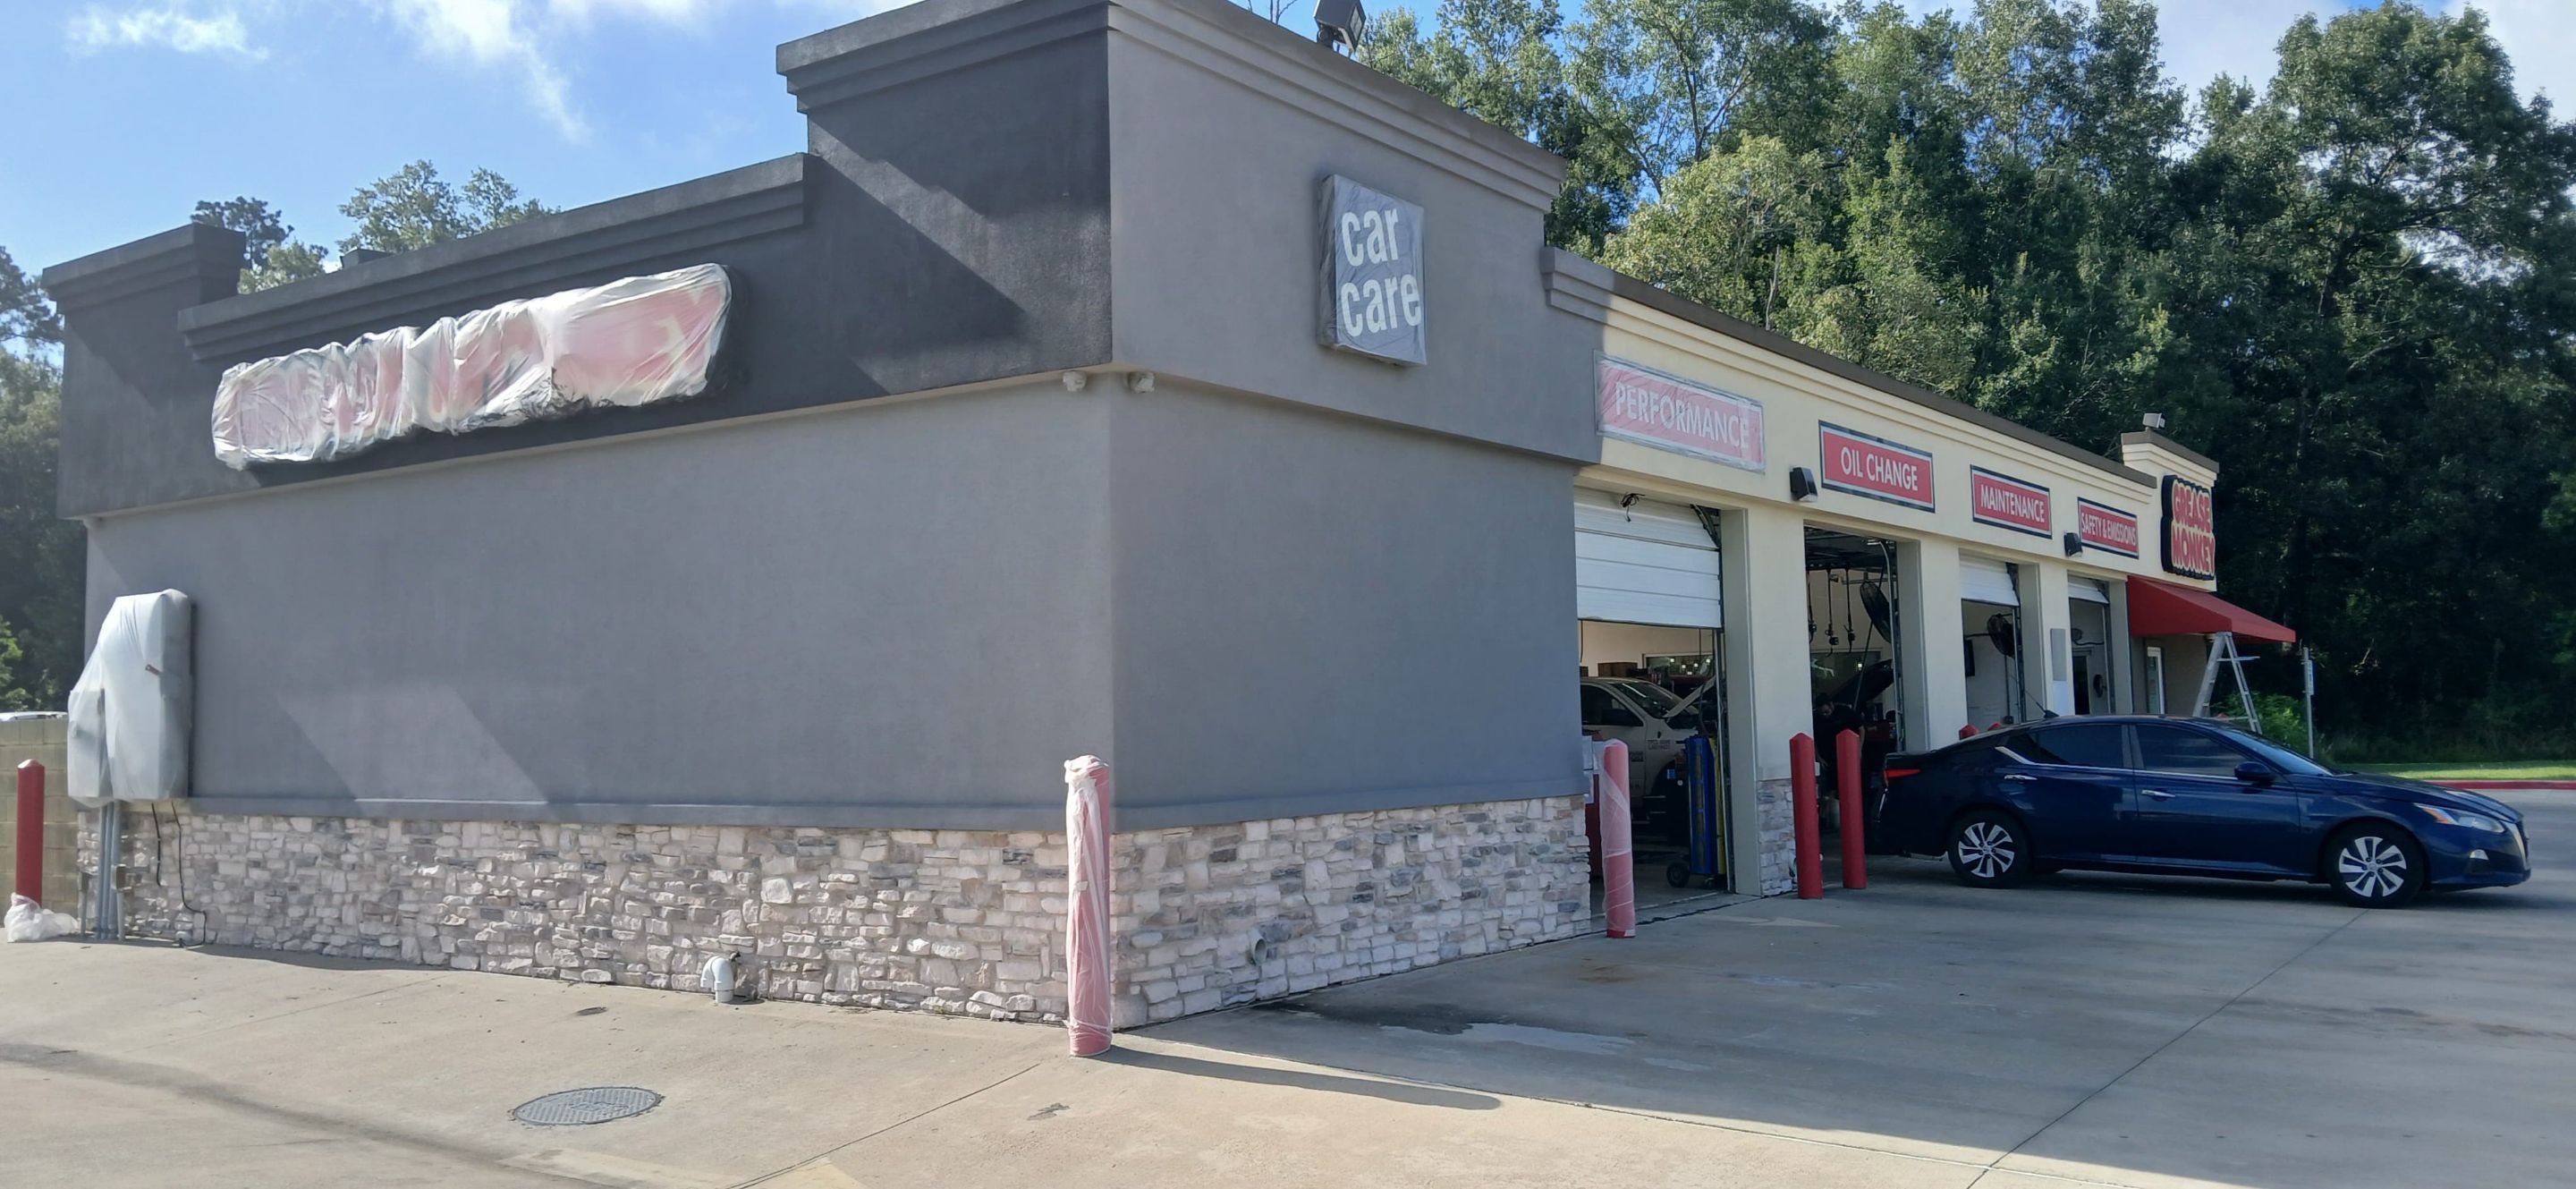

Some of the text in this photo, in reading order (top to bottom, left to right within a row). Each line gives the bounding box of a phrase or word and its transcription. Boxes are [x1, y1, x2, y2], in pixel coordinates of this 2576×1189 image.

[1342, 208, 1398, 267] car
[1342, 274, 1421, 337] care
[1615, 381, 1750, 448] PERFORMANCE
[1841, 446, 1919, 491] OIL CHANGE
[1980, 484, 2045, 523] MAINTENANCE
[2080, 512, 2102, 538] SAFETY
[2172, 480, 2212, 534] GREASE
[2172, 522, 2215, 575] MONKEY
